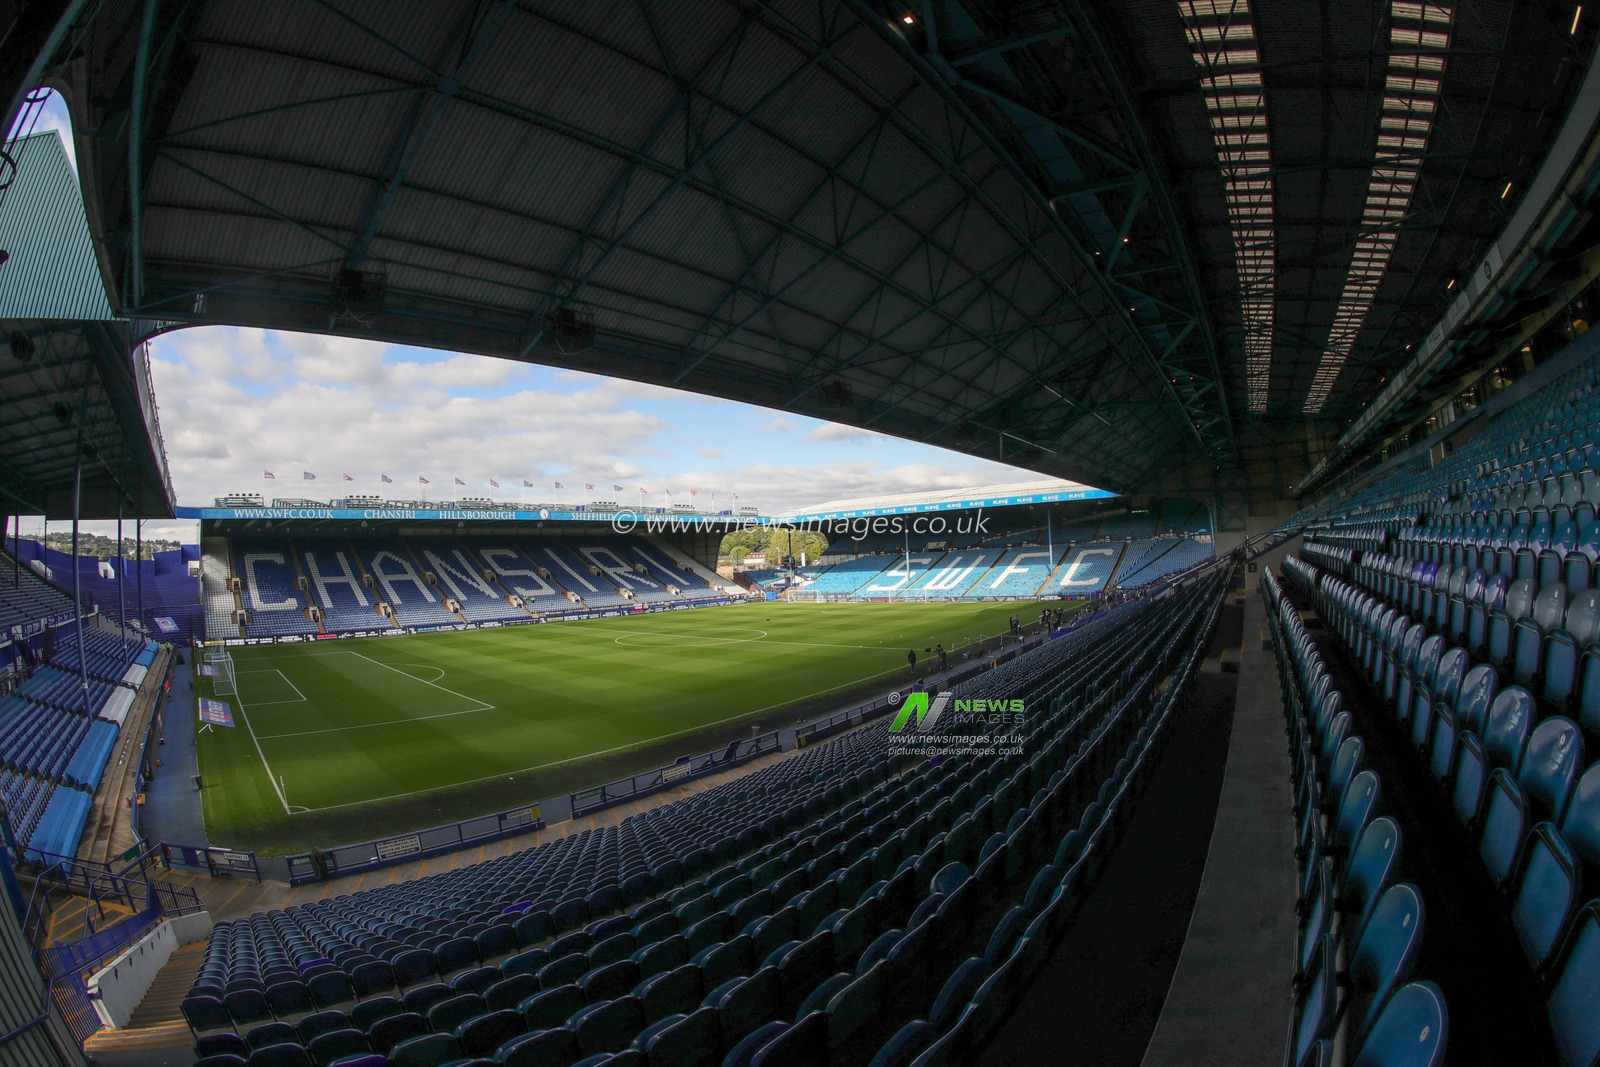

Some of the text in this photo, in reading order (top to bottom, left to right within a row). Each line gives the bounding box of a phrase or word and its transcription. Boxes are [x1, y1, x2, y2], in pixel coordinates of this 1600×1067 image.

[234, 508, 334, 519] WWW.SWFC.CO.UK
[364, 509, 416, 520] CHANSIRI
[439, 510, 516, 520] HILLSBOROUGH
[867, 547, 1114, 592] SWFC
[244, 546, 690, 612] CHANSIRI
